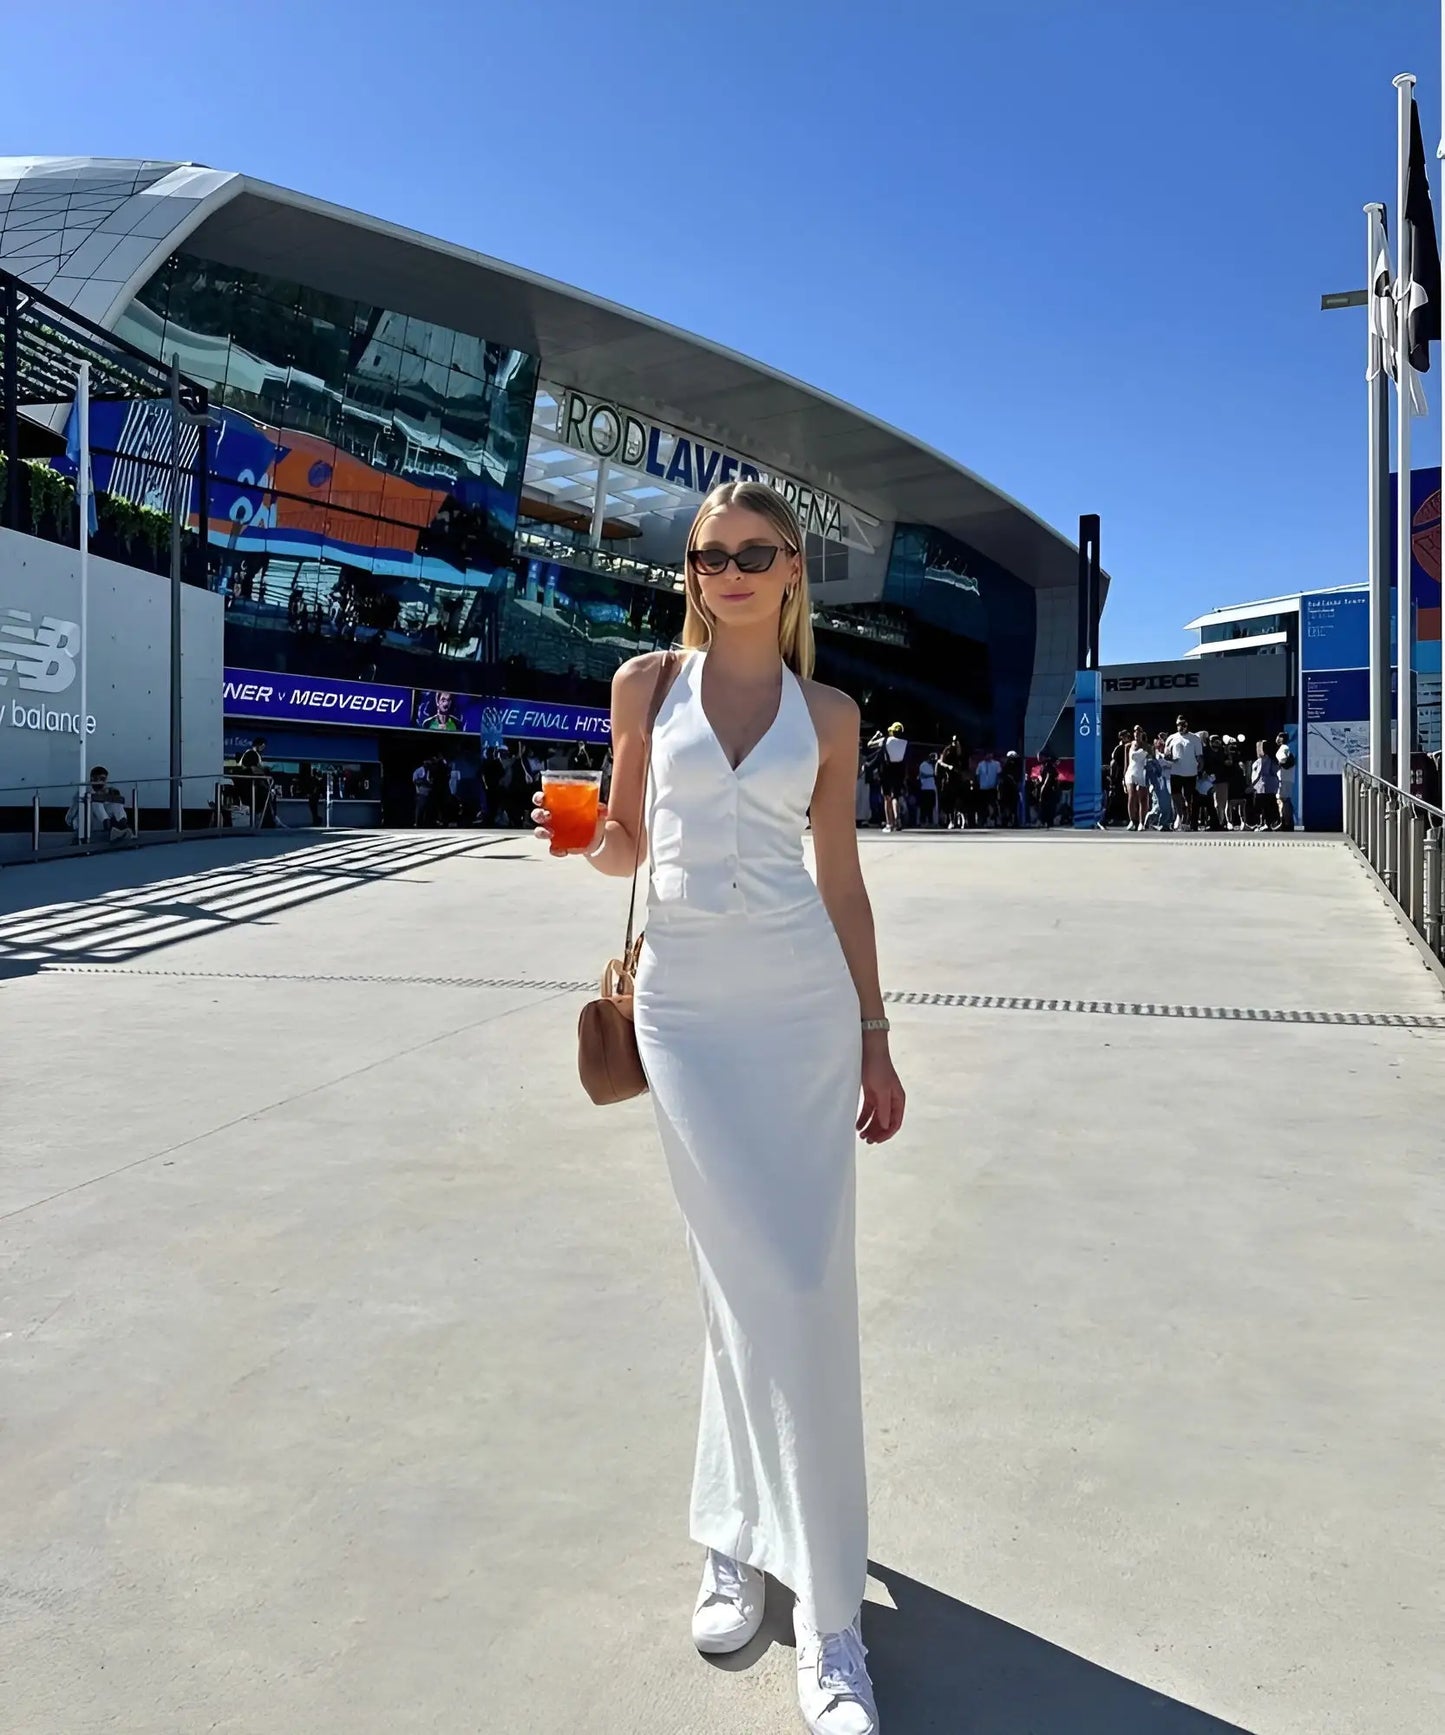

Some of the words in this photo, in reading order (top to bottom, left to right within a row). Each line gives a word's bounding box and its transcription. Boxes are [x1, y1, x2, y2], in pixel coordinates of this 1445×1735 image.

[566, 392, 646, 466] ROD
[771, 477, 842, 541] RENA
[1103, 673, 1199, 691] REPIECE
[223, 682, 273, 702] NER
[290, 689, 403, 713] MEDVEDEV
[521, 711, 569, 730] FINAL
